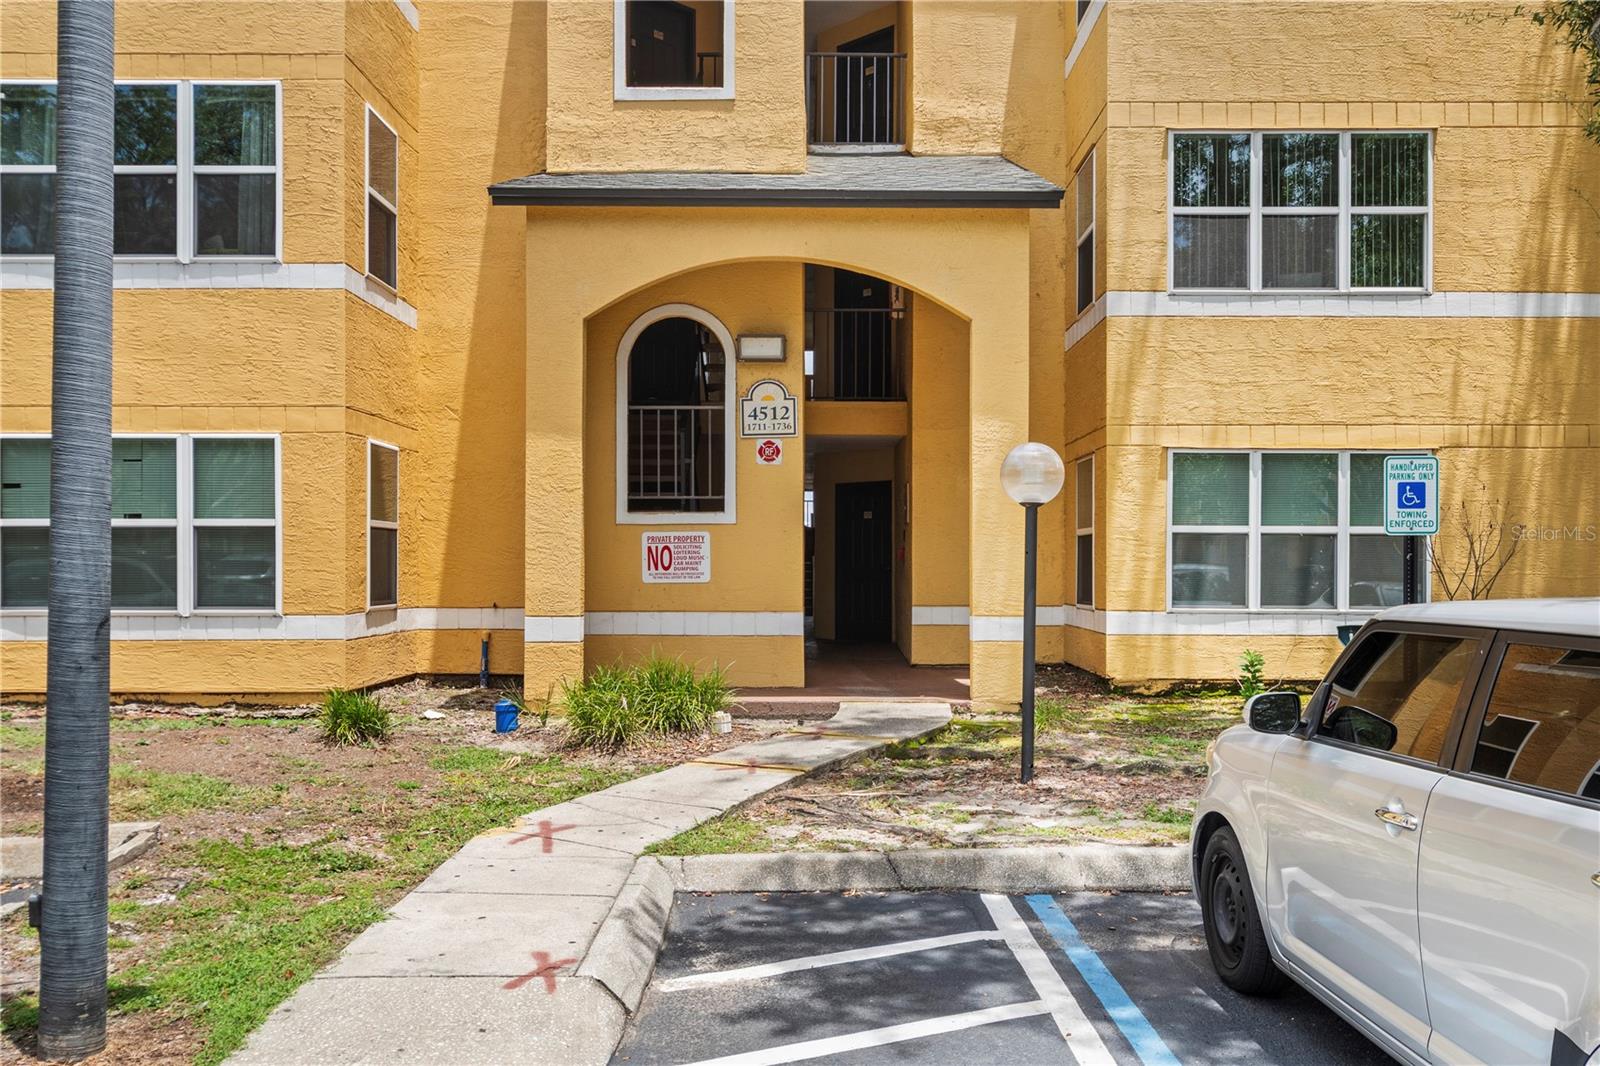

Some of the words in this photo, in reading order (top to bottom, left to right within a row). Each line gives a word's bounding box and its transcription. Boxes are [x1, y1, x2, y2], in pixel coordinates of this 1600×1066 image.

[748, 406, 790, 420] 4512
[748, 423, 792, 431] 1711-1736
[765, 447, 774, 456] RF
[1390, 463, 1434, 471] HANDICAPPED
[1389, 472, 1416, 480] PARKING
[1418, 472, 1434, 480] ONLY
[1397, 511, 1427, 519] TOWING
[1389, 520, 1434, 528] ENFORCED
[647, 545, 673, 571] NO
